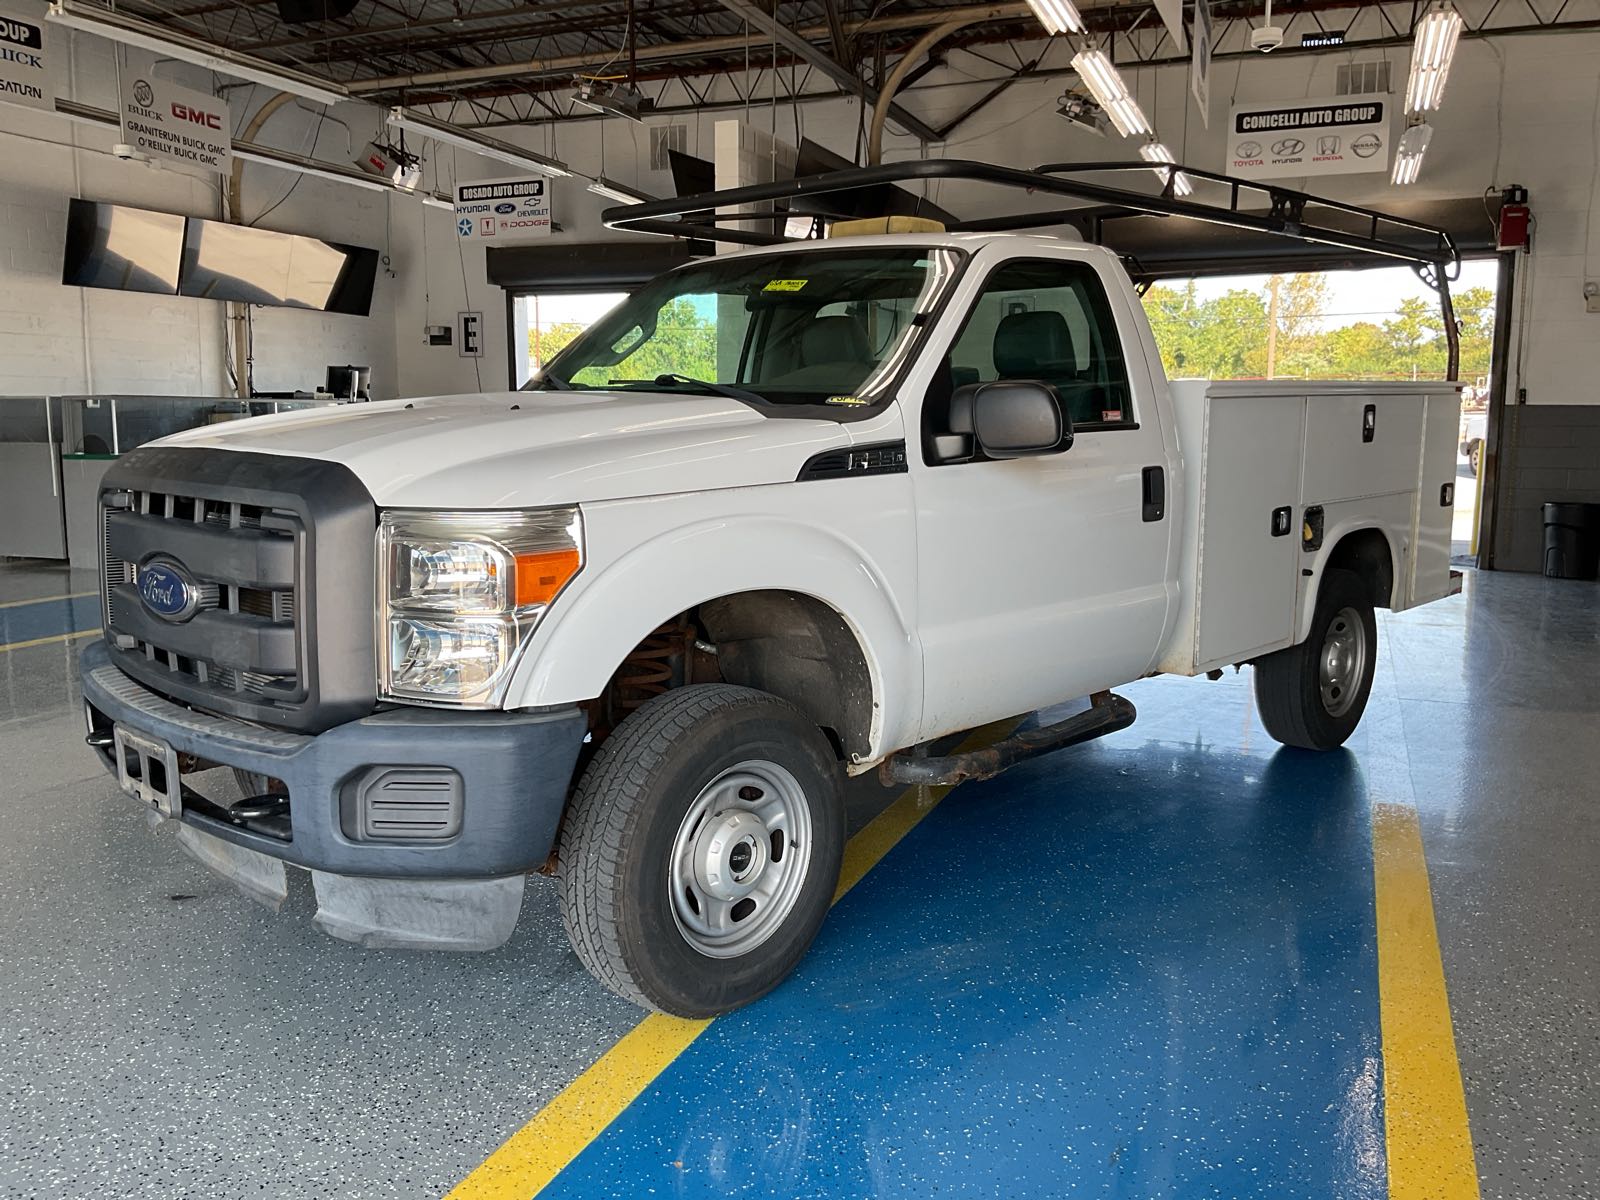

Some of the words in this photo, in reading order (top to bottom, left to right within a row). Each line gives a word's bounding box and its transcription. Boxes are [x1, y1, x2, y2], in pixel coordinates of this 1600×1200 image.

[128, 104, 163, 122] BUICK
[171, 102, 221, 130] GMC
[1242, 113, 1300, 130] CONICELLI
[1301, 109, 1332, 125] AUTO
[1334, 107, 1376, 122] GROUP
[127, 120, 180, 143] GRANITERUN
[182, 136, 206, 151] BUICK
[207, 144, 226, 156] GMC
[138, 137, 172, 153] O'REILLY
[174, 147, 198, 161] BUICK
[200, 154, 218, 166] GMC
[1312, 154, 1343, 162] HONDA
[1233, 158, 1264, 168] TOYOTA
[1272, 157, 1303, 165] HYUNDAI
[463, 186, 492, 199] ROSADO
[493, 184, 512, 197] AUTO
[513, 182, 539, 196] GROUP
[456, 204, 491, 214] HYUNDAI
[517, 208, 549, 217] CHEVROLET
[510, 219, 549, 228] DODGE
[463, 316, 478, 353] E
[143, 571, 174, 606] Ford
